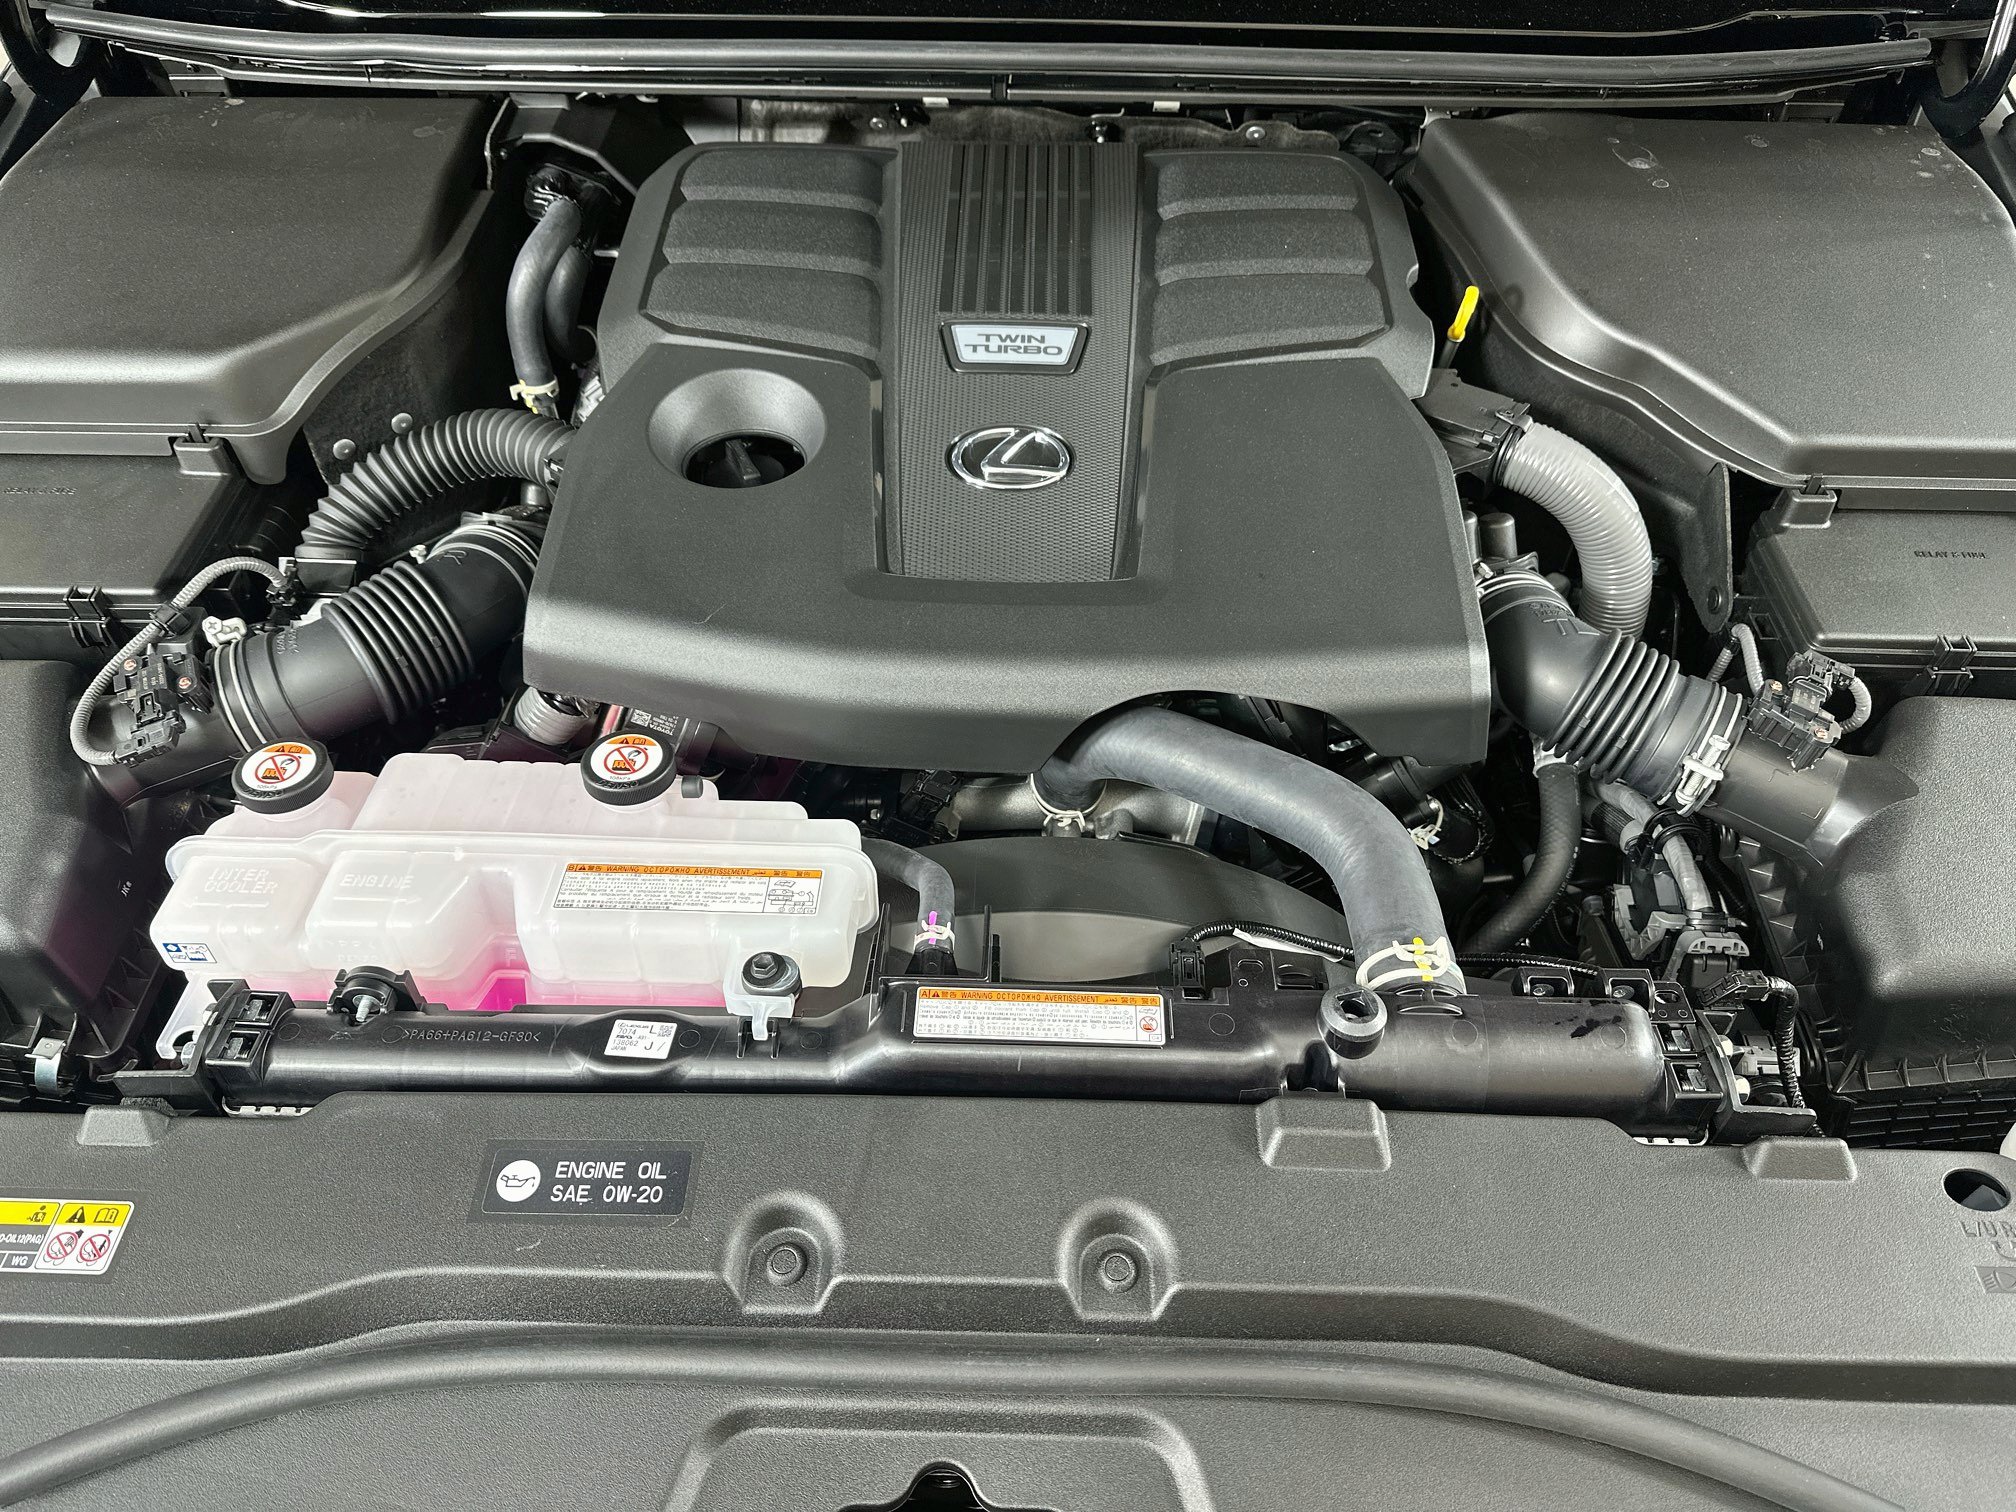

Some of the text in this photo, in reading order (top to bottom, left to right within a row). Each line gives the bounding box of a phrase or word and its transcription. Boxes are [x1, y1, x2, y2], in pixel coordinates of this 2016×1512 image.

[977, 333, 1046, 344] TWIN
[964, 344, 1063, 356] TURBO
[649, 723, 674, 736] TOYOTA
[208, 867, 271, 881] INTER
[606, 865, 640, 873] WARNING
[693, 867, 750, 876] AVERTISSEMENT
[339, 873, 415, 889] ENGINE
[203, 880, 279, 895] COOLER
[921, 990, 928, 998] A
[1044, 994, 1099, 1003] AVERTISSEMENT
[619, 1027, 637, 1035] 7074
[649, 1025, 658, 1035] L
[644, 1041, 653, 1051] J
[555, 1161, 667, 1180] ENGINE OIL
[550, 1185, 664, 1203] SAE 0W-20
[11, 1255, 29, 1267] WG
